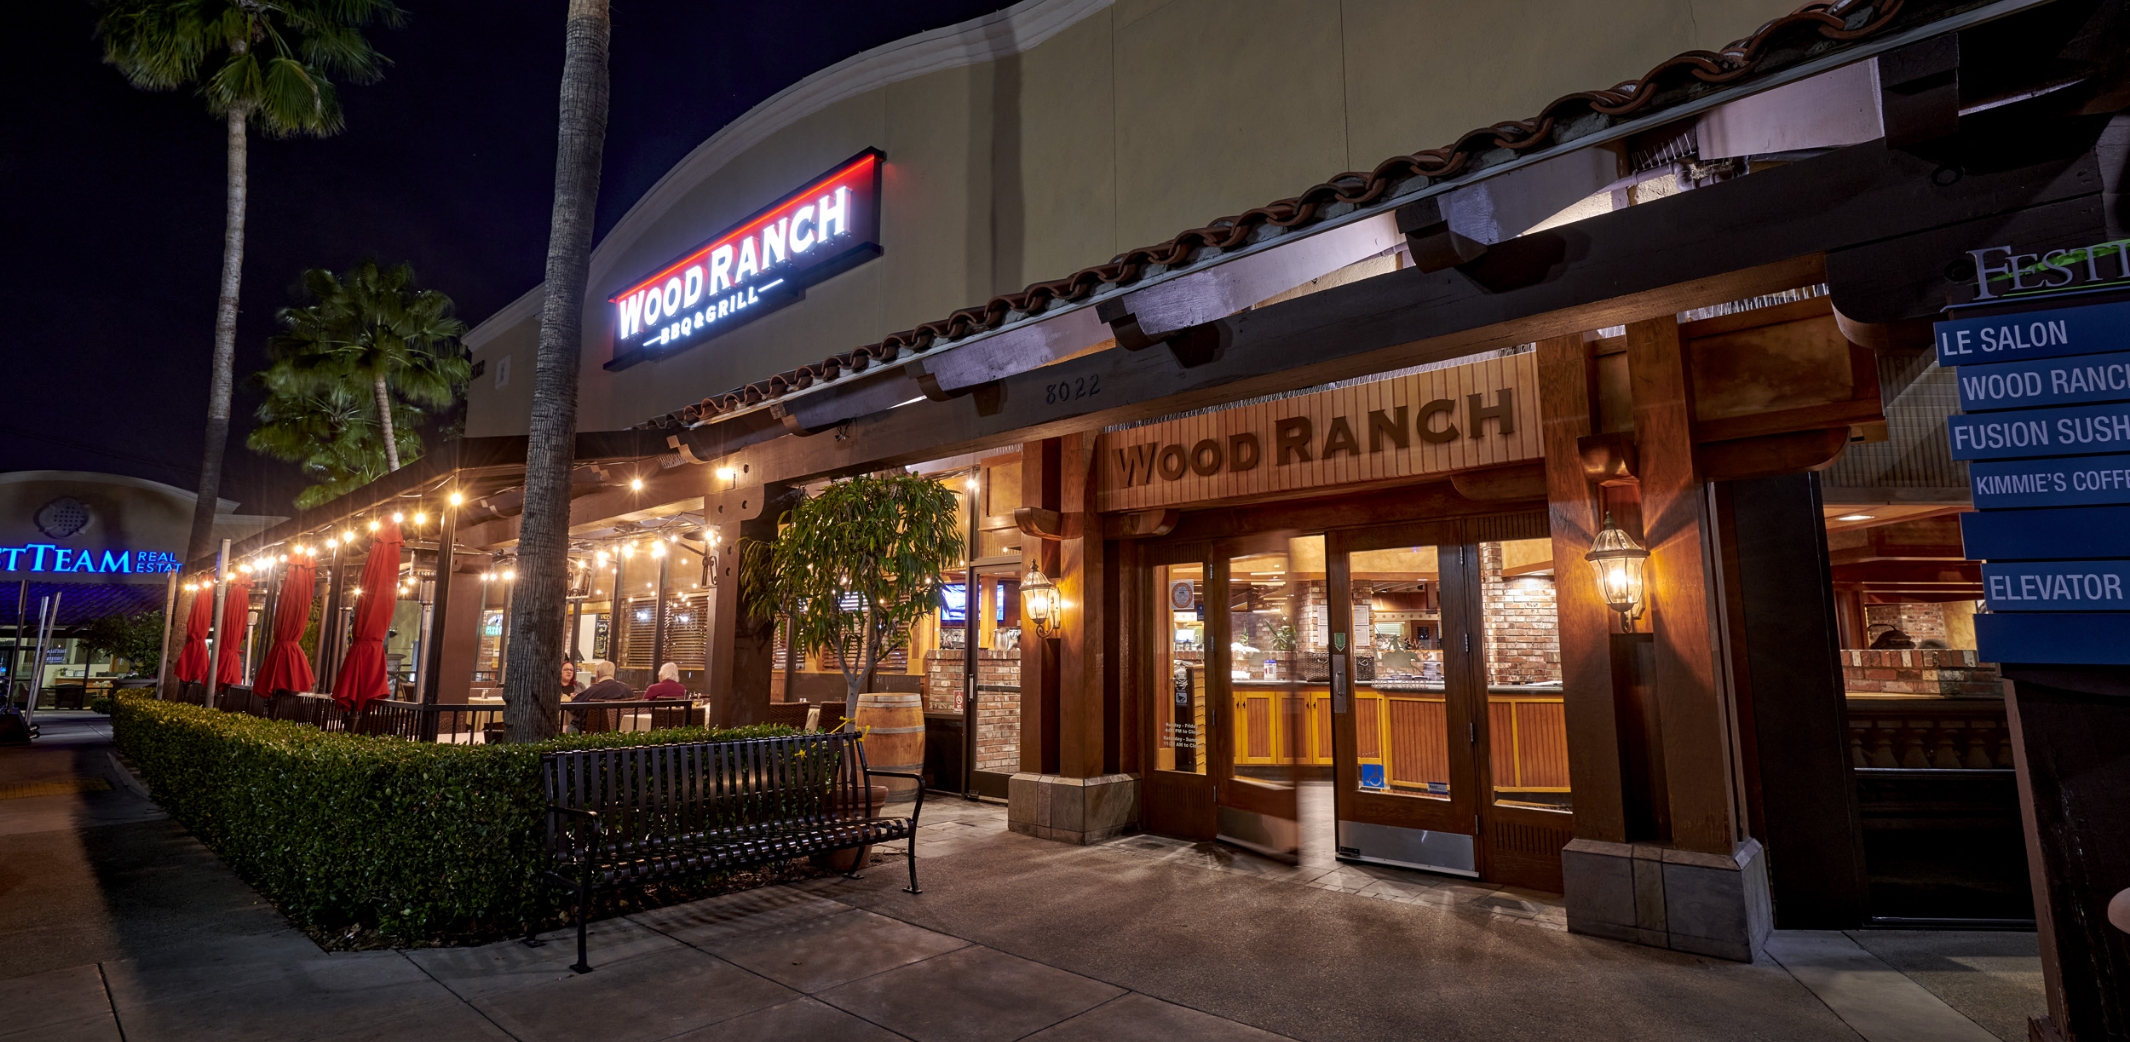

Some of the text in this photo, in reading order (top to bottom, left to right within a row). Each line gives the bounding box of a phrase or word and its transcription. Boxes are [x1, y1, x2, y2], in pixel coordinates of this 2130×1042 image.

[619, 185, 850, 340] WOOD RANCH
[1942, 320, 2068, 356] LE SALON
[1046, 373, 1100, 405] 8022
[1963, 372, 2042, 400] WOOD
[1112, 388, 1514, 488] WOOD RANCH
[1954, 420, 2049, 450] FUSION
[1976, 473, 2067, 495] KIMMIE'S
[136, 562, 183, 573] ESTAT
[138, 551, 177, 562] REAL
[1989, 573, 2123, 600] ELEVATOR
